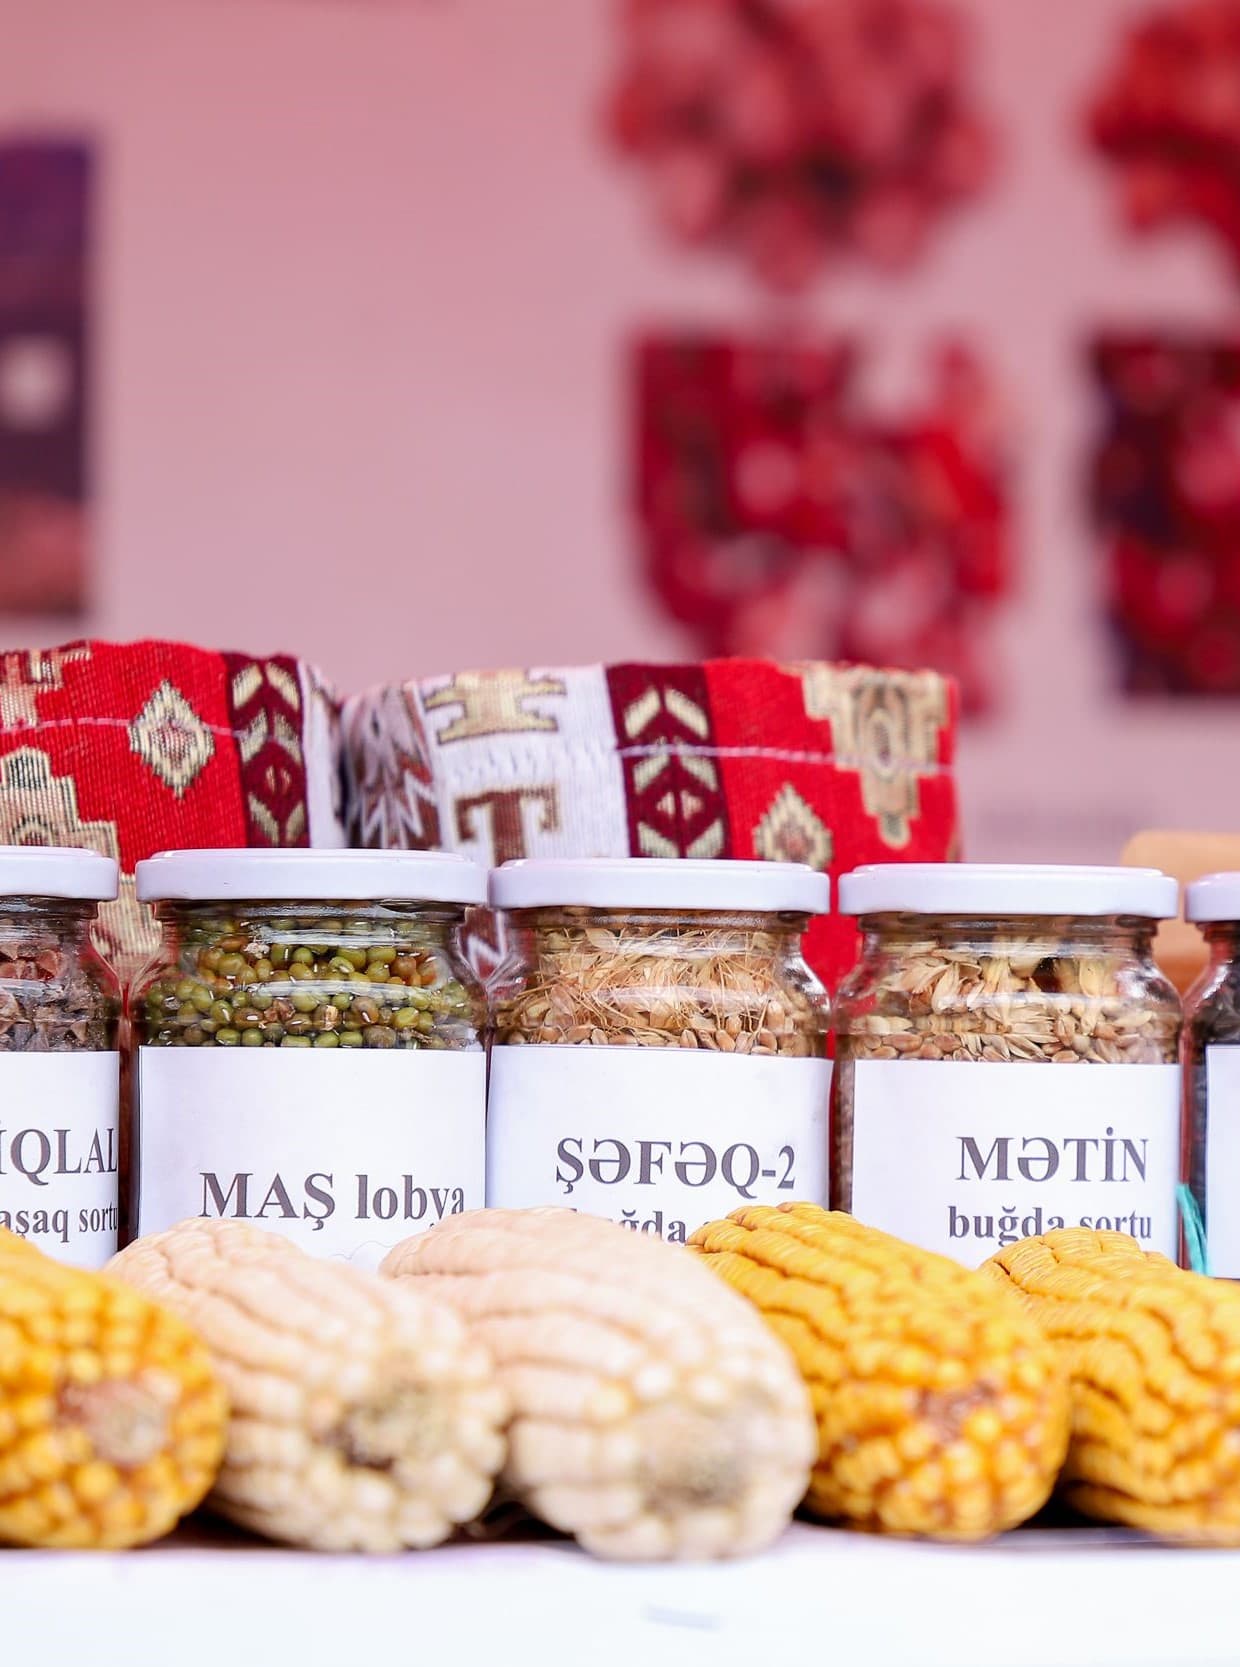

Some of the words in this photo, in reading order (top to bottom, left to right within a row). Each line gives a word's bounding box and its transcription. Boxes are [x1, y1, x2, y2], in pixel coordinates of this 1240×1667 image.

[555, 1137, 796, 1199] ŞƏFƏQ-2
[955, 1126, 1149, 1182] MƏTİN
[197, 1172, 336, 1232] MAŞ
[353, 1173, 465, 1228] lobya
